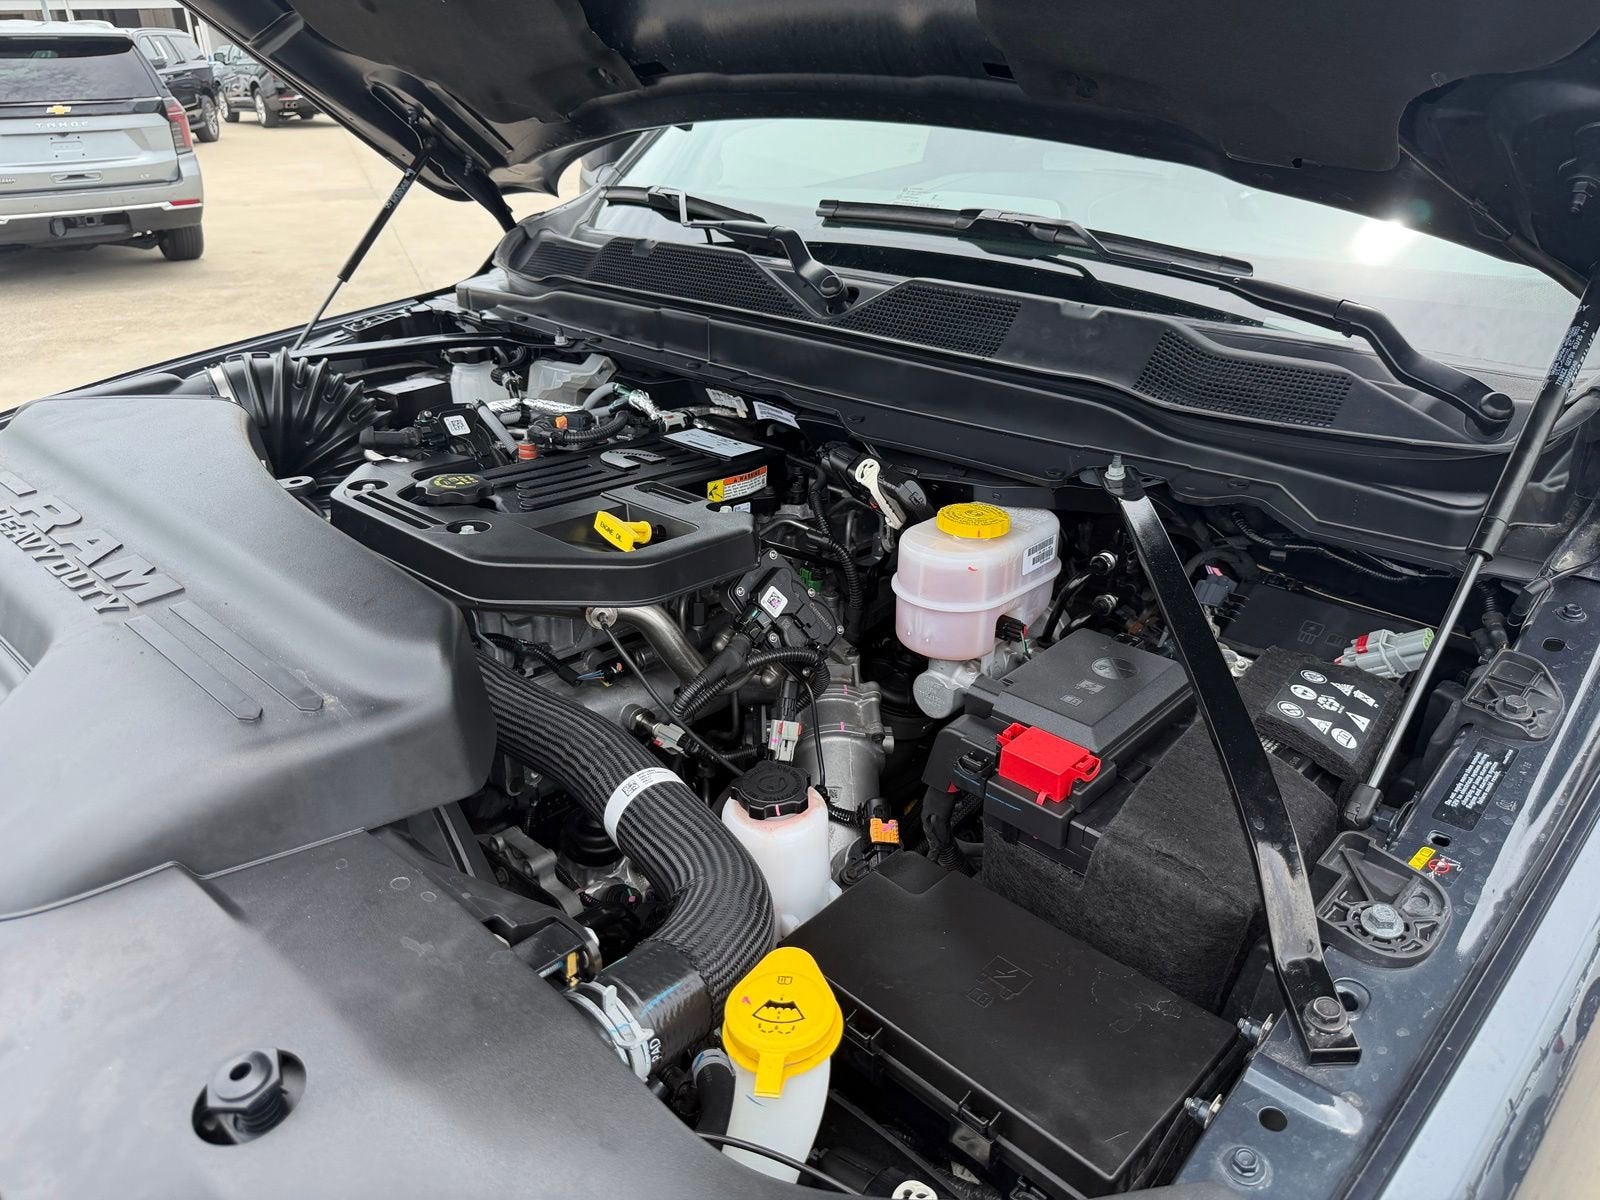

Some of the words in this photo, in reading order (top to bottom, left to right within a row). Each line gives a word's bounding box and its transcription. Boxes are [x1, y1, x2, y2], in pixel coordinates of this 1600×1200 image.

[600, 521, 614, 536] ENGINE
[10, 494, 186, 607] RAM
[44, 557, 130, 614] DUTY
[809, 602, 833, 630] Cummins
[650, 1038, 662, 1062] RAD
